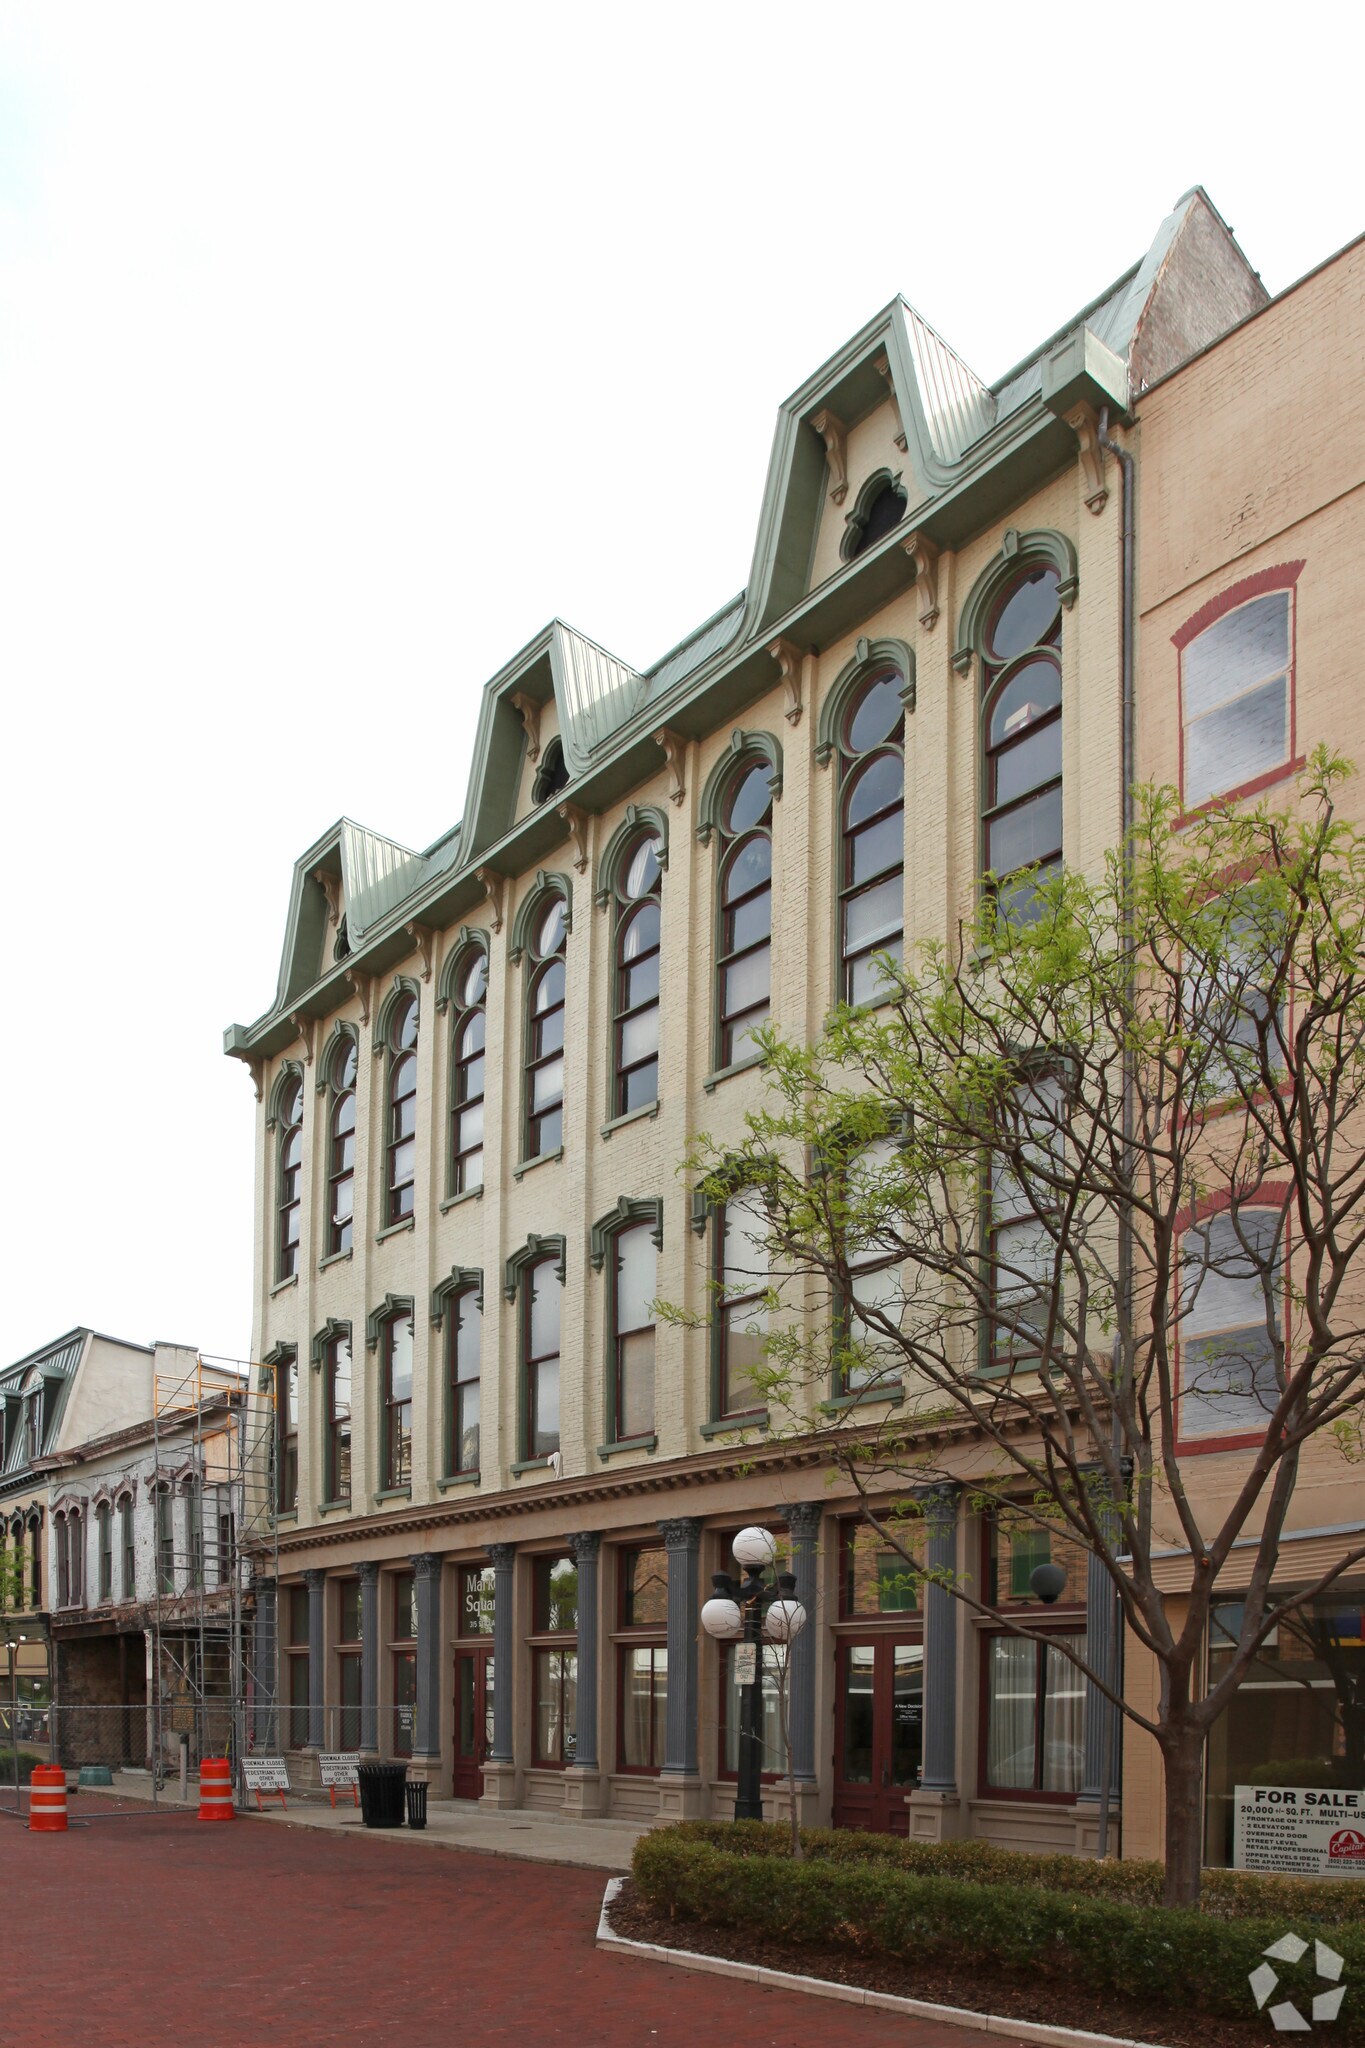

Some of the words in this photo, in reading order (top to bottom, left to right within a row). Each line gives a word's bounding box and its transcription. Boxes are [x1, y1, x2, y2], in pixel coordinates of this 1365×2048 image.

[1255, 1790, 1296, 1804] FOR
[1304, 1792, 1358, 1807] SALE
[1241, 1806, 1274, 1814] 20,000
[1246, 1844, 1328, 1854] RETAIL/PROFESSIONAL
[1332, 1842, 1362, 1854] Capital
